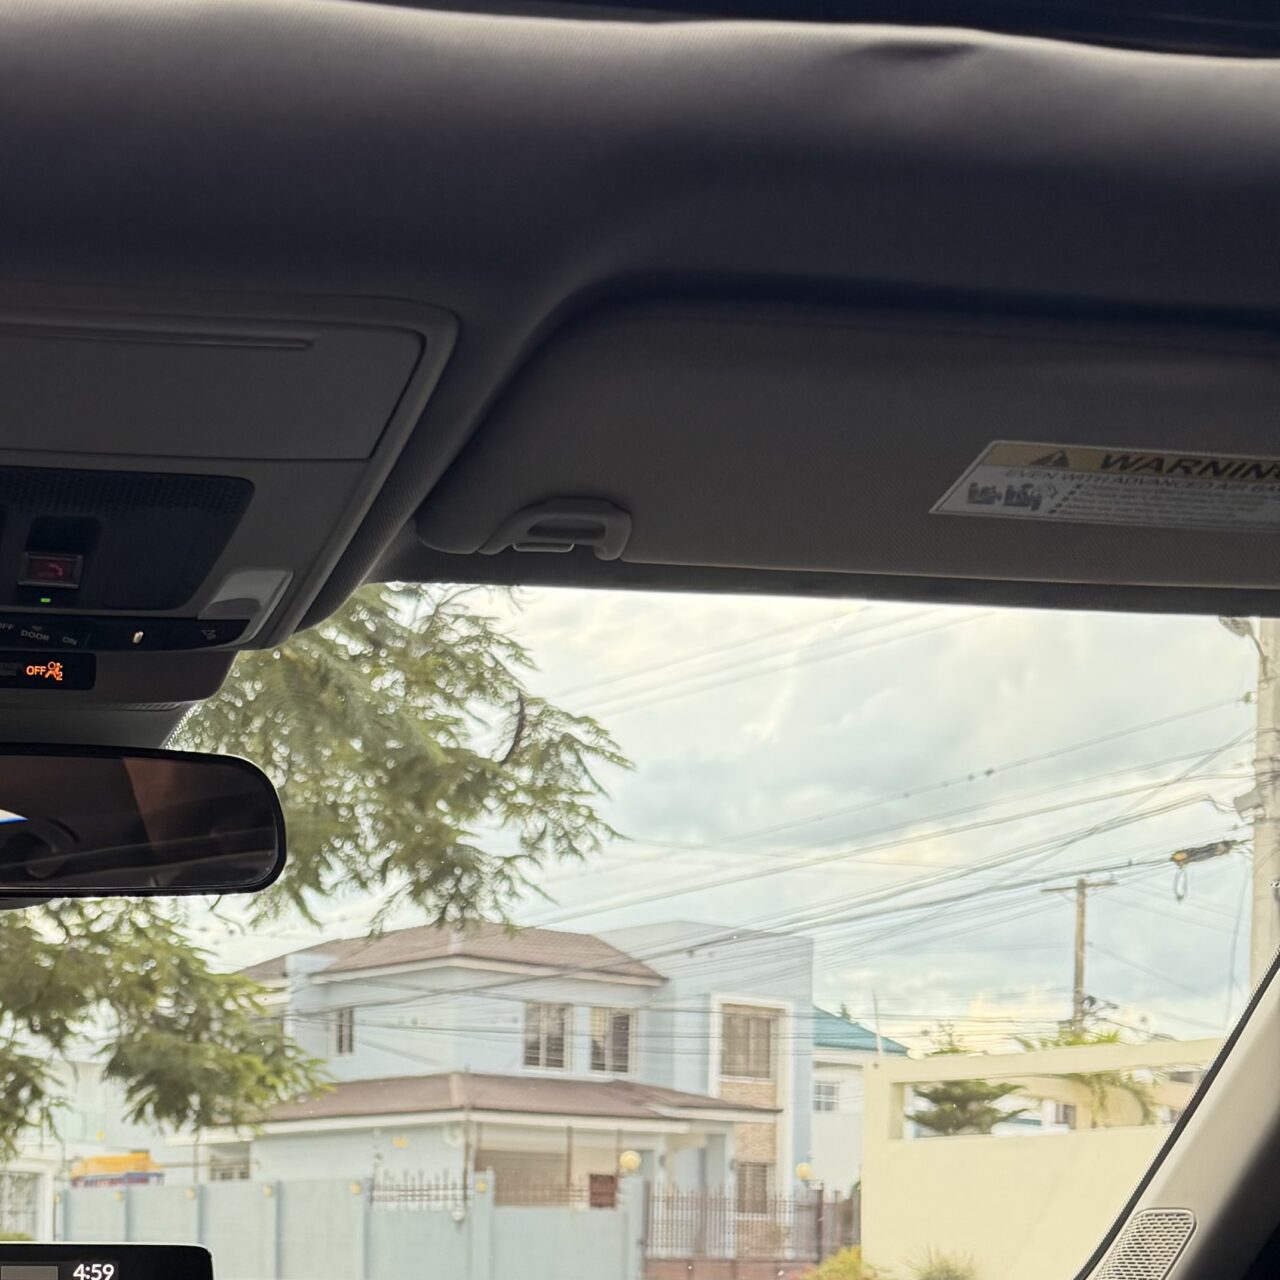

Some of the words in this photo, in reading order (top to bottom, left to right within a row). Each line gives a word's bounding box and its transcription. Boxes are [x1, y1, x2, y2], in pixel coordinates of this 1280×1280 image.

[1100, 454, 1280, 480] WARNIN
[20, 629, 50, 642] DOOR
[62, 636, 78, 645] ON
[25, 665, 47, 676] OFF
[73, 1263, 115, 1280] 4:59
